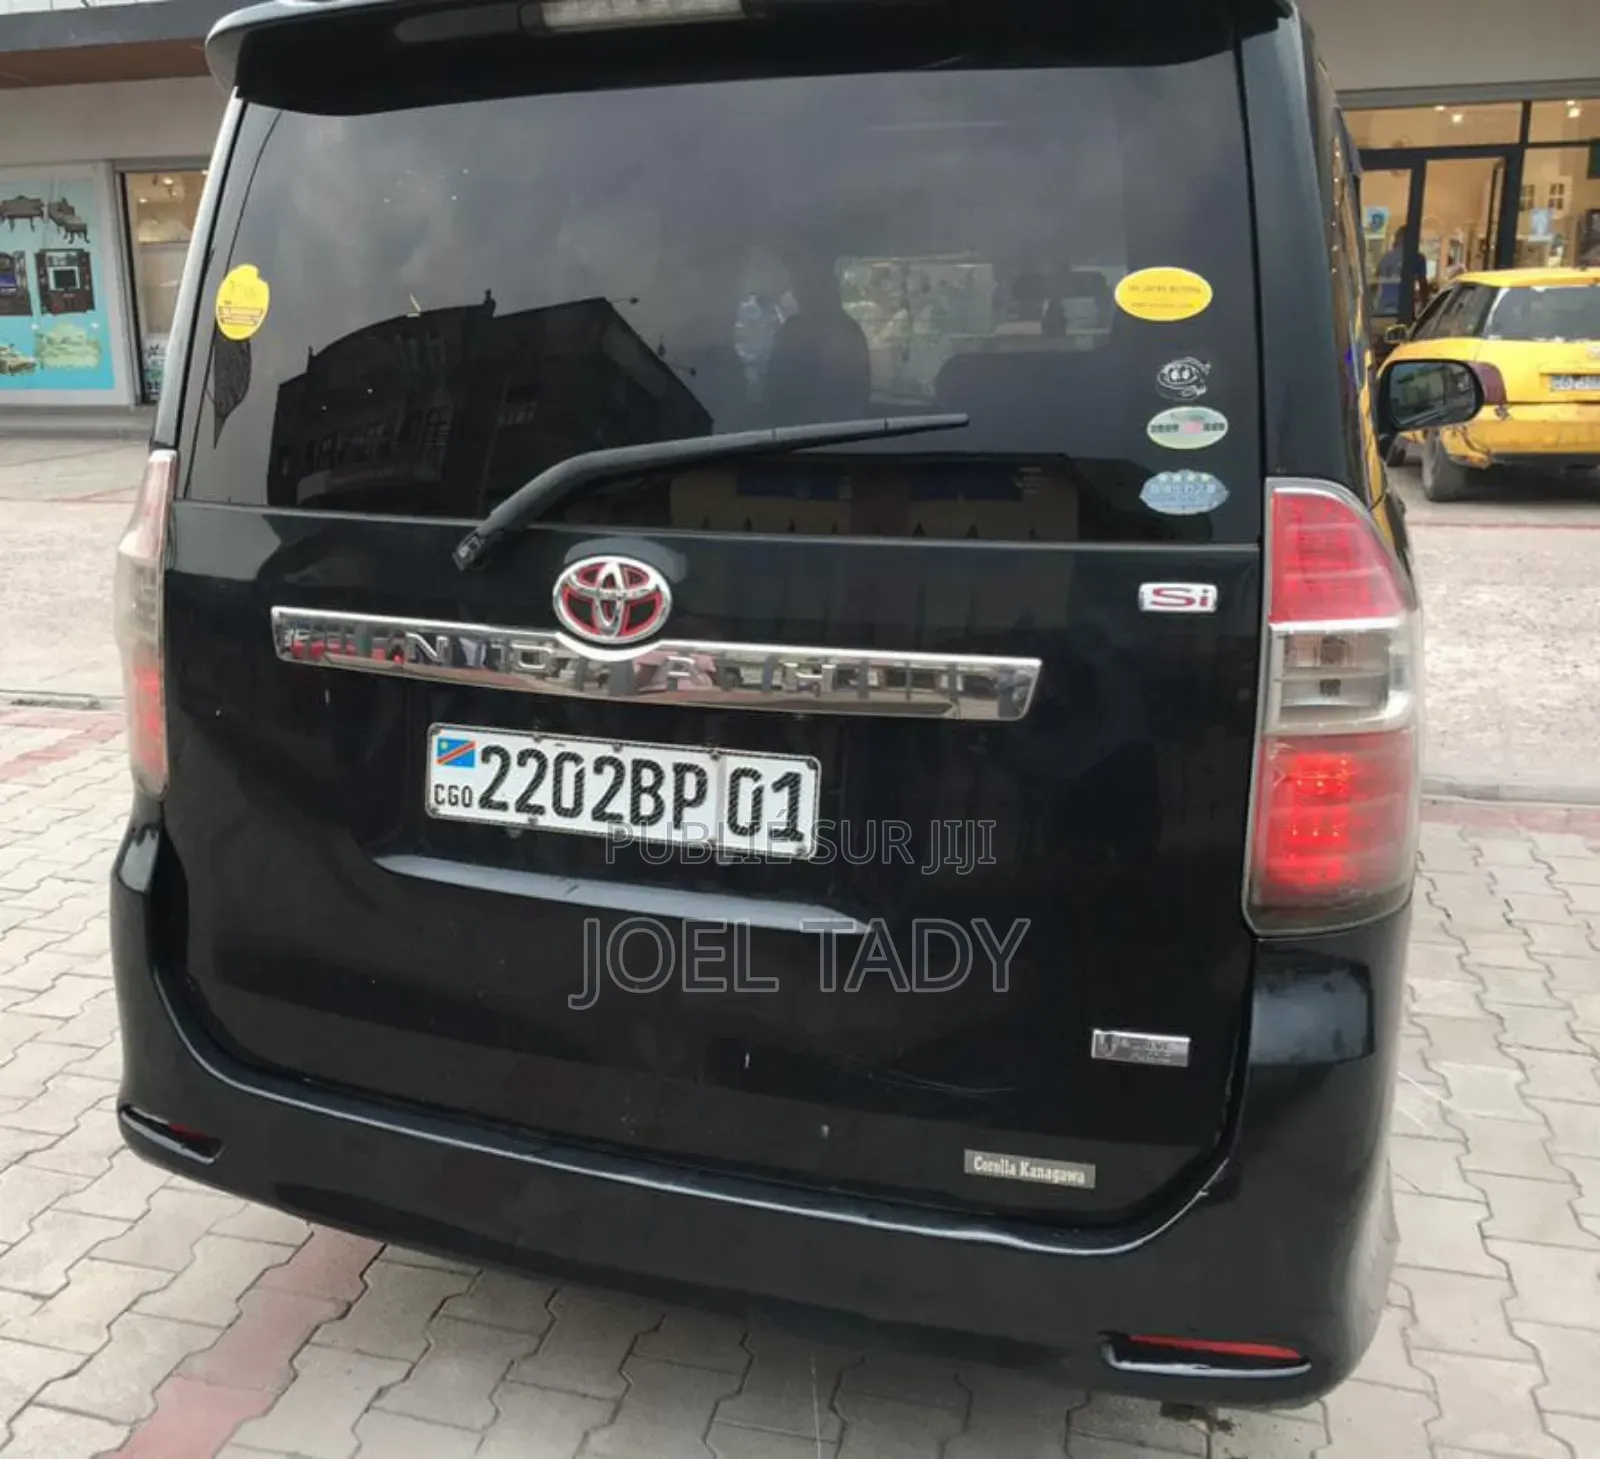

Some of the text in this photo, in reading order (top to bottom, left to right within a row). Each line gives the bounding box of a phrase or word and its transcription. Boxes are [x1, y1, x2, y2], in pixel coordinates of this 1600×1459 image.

[1151, 587, 1209, 607] Si
[434, 784, 473, 808] CGO
[478, 745, 804, 842] 2202BP 01
[974, 1156, 1086, 1184] Corolla Kanagawa
